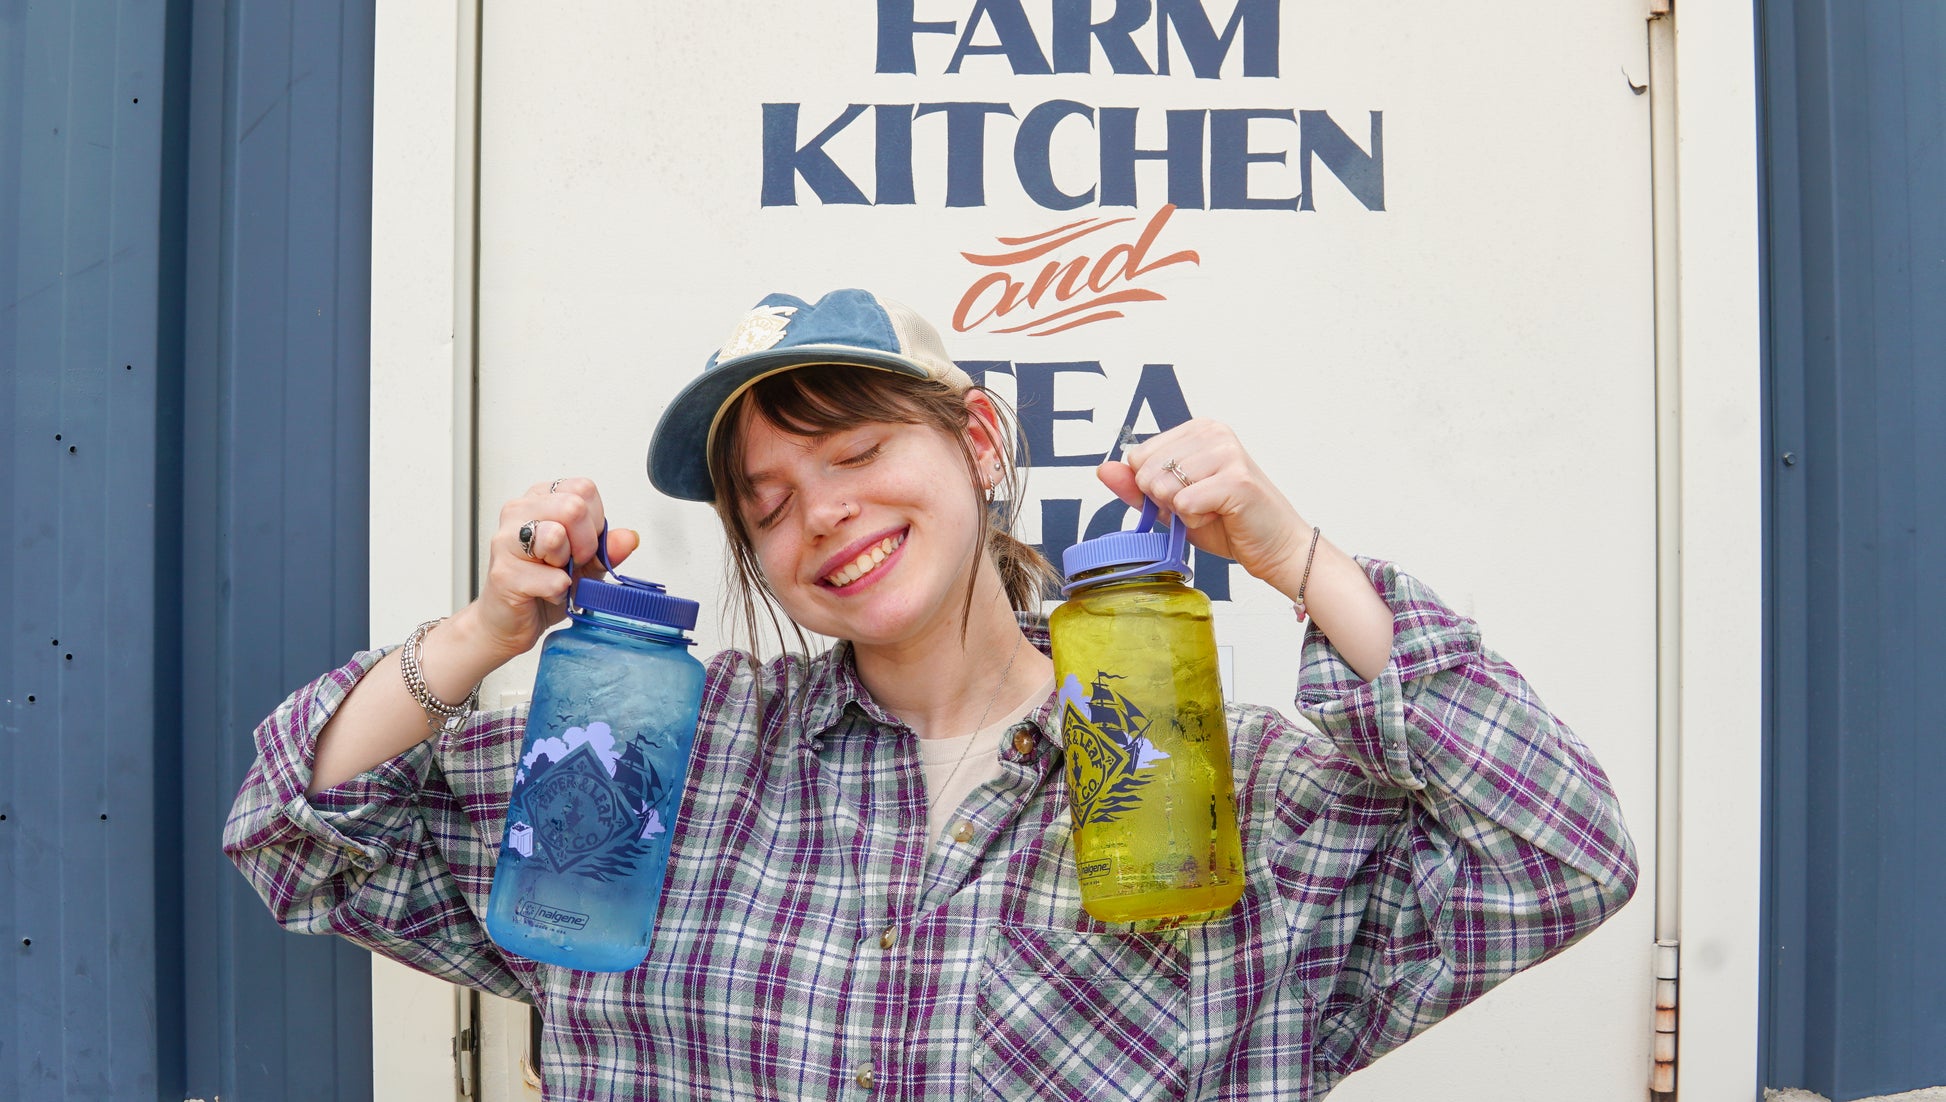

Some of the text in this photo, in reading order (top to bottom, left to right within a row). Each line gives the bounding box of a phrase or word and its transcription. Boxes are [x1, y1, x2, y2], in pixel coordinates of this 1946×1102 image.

[875, 0, 1280, 79] FARM
[761, 99, 1386, 212] KITCHEN
[952, 203, 1200, 332] and
[952, 359, 1194, 468] EA
[578, 777, 589, 793] &
[538, 909, 582, 926] nalgene
